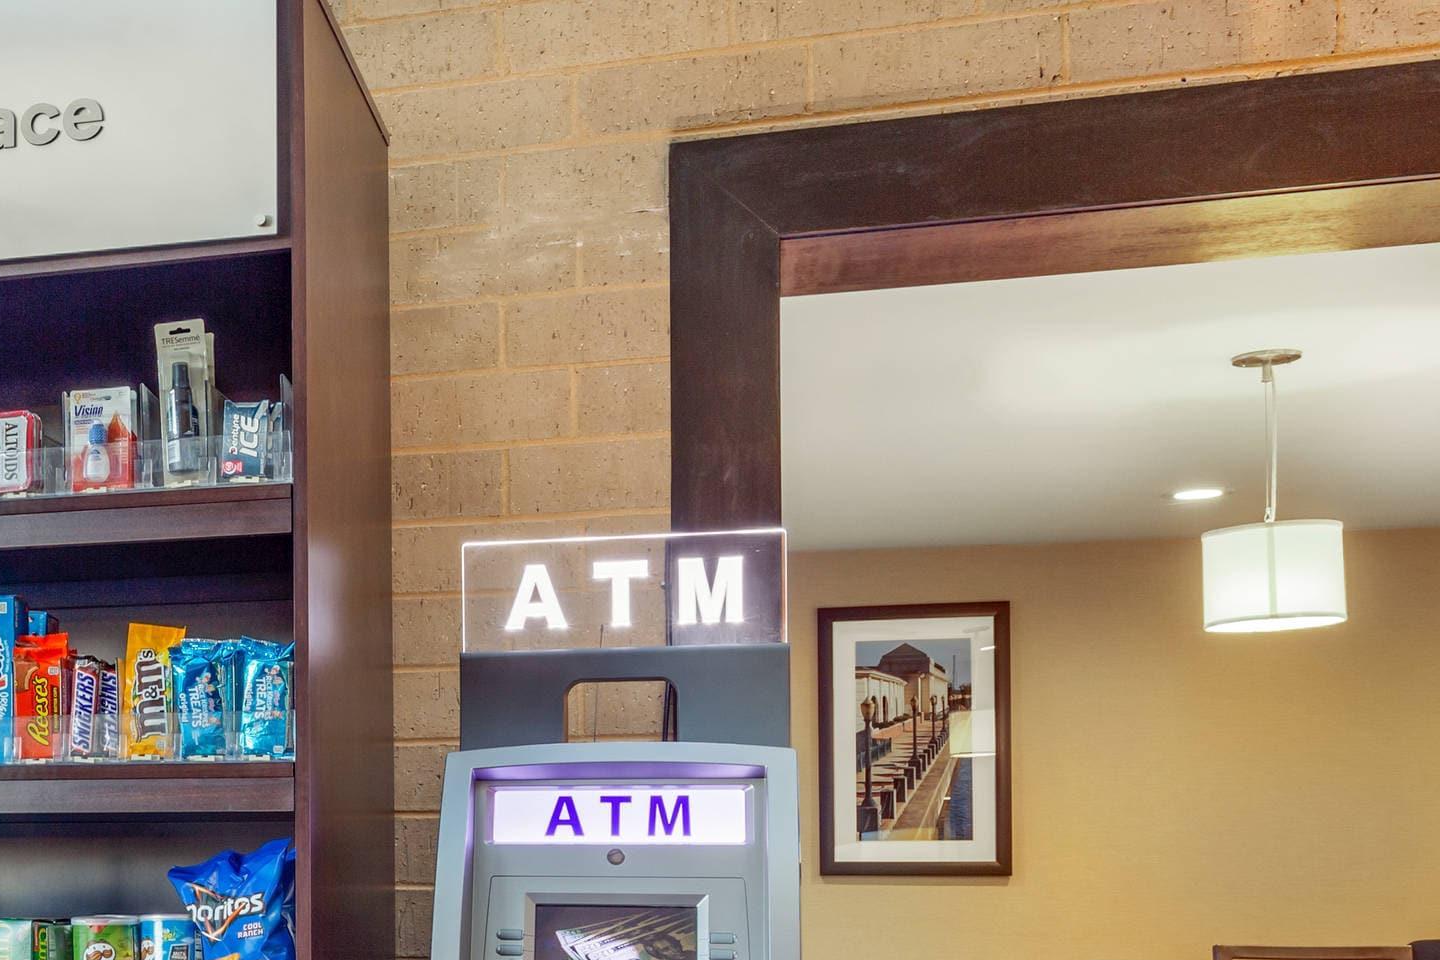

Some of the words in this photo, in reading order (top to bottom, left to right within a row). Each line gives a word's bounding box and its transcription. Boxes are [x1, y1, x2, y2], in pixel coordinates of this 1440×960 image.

[73, 404, 104, 417] Visine
[4, 422, 20, 481] ALTOIDS
[229, 414, 240, 455] Dentyne
[240, 415, 259, 457] ICE
[504, 555, 746, 631] ATM
[73, 670, 97, 751] SNICKERS
[188, 685, 202, 728] TREATS
[254, 676, 266, 720] TREATS
[545, 794, 692, 837] ATM
